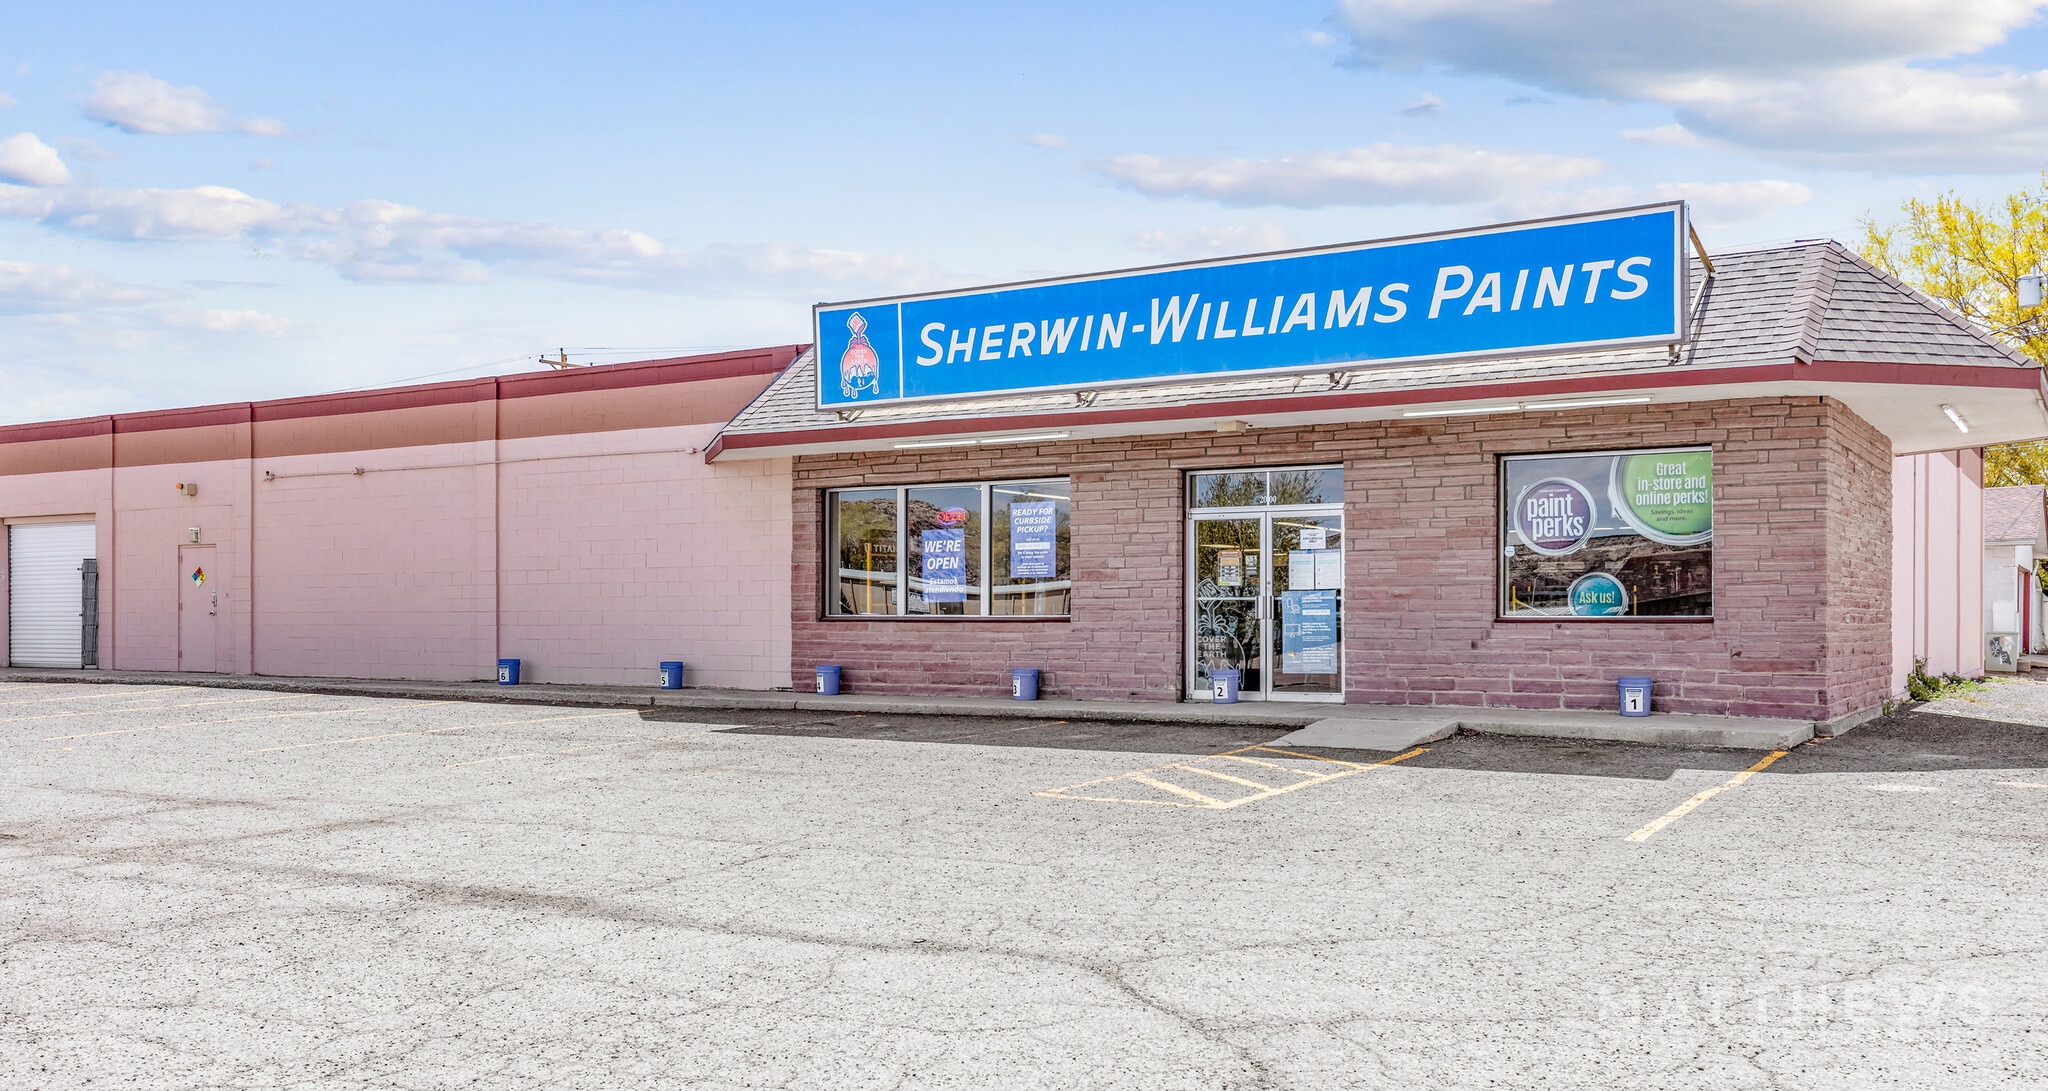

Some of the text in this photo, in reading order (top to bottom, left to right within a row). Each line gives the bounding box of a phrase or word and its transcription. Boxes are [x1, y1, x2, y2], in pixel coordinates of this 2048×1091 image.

[1428, 256, 1652, 319] PAINTS
[1656, 462, 1687, 476] Great
[1637, 475, 1706, 491] in-store and
[1635, 490, 1708, 506] online perks!
[1012, 507, 1053, 516] READY FOR
[1527, 493, 1573, 521] paint
[936, 511, 967, 522] OPEN
[1014, 516, 1051, 524] CURBSIDE
[1016, 525, 1048, 533] PICKUP?
[1532, 514, 1583, 542] perks
[924, 540, 961, 553] WE'RE
[927, 557, 959, 570] OPEN
[924, 585, 964, 593] atendiendo
[1579, 591, 1615, 604] Ask us!
[1197, 635, 1227, 643] COVER
[1197, 650, 1227, 658] EARTH
[501, 672, 506, 680] 6
[661, 677, 666, 685] 5
[1217, 687, 1223, 697] 2
[1630, 698, 1637, 710] 1
